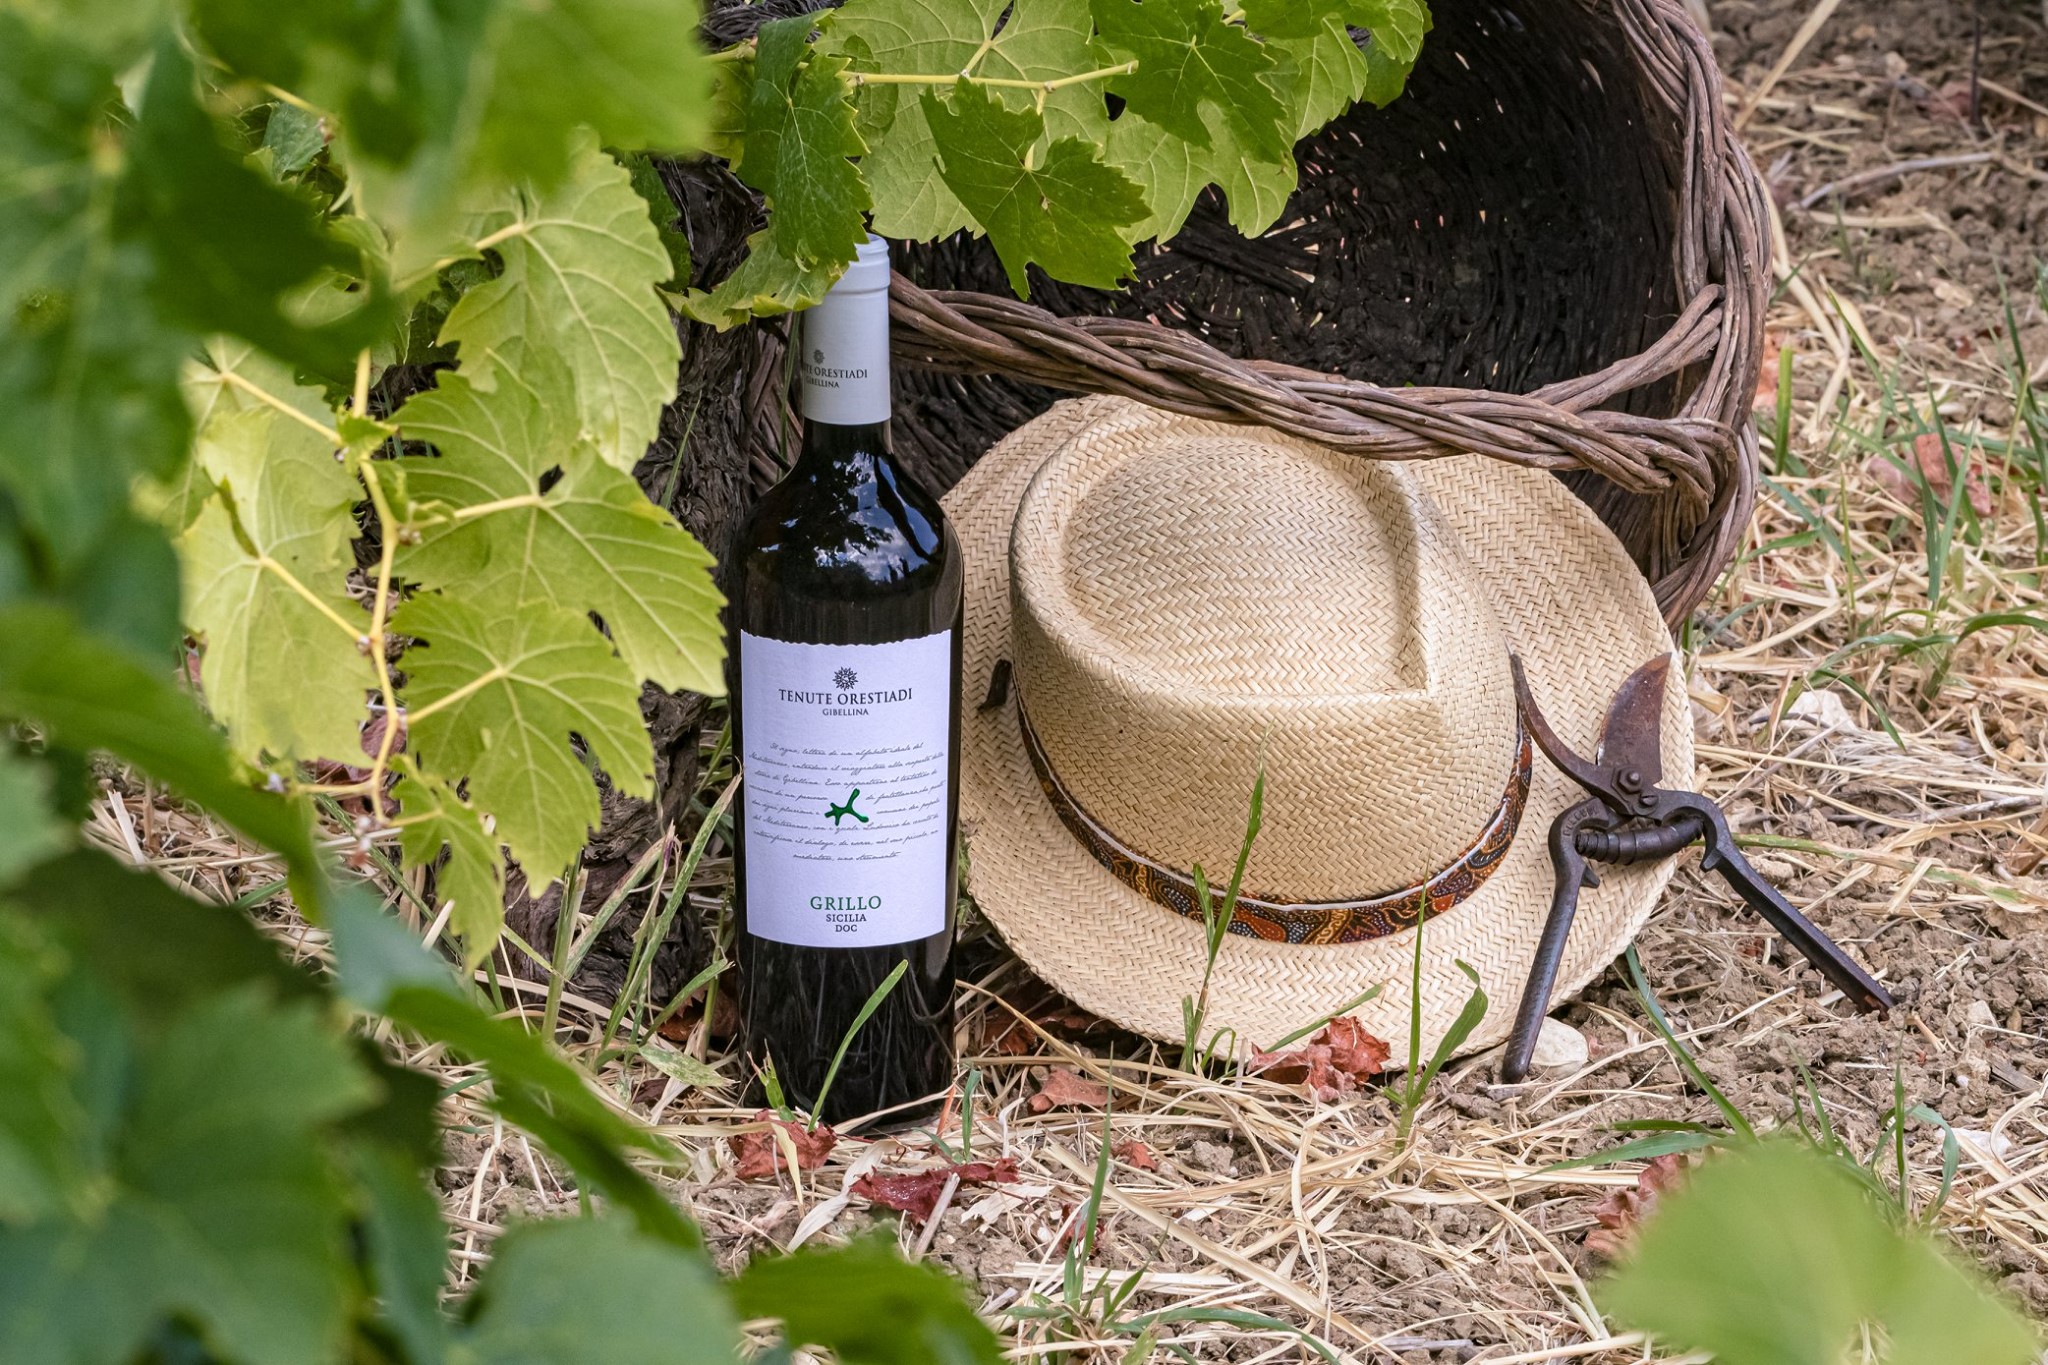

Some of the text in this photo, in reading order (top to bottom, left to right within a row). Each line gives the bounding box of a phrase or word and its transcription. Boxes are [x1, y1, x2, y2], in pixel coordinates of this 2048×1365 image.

[814, 366, 868, 379] ORESTIADI
[778, 688, 912, 706] TENUTE ORESTIADI
[822, 708, 869, 716] GIBELLINA
[810, 895, 882, 911] GRILLO
[825, 914, 867, 922] SICILIA
[835, 924, 858, 932] DOC
